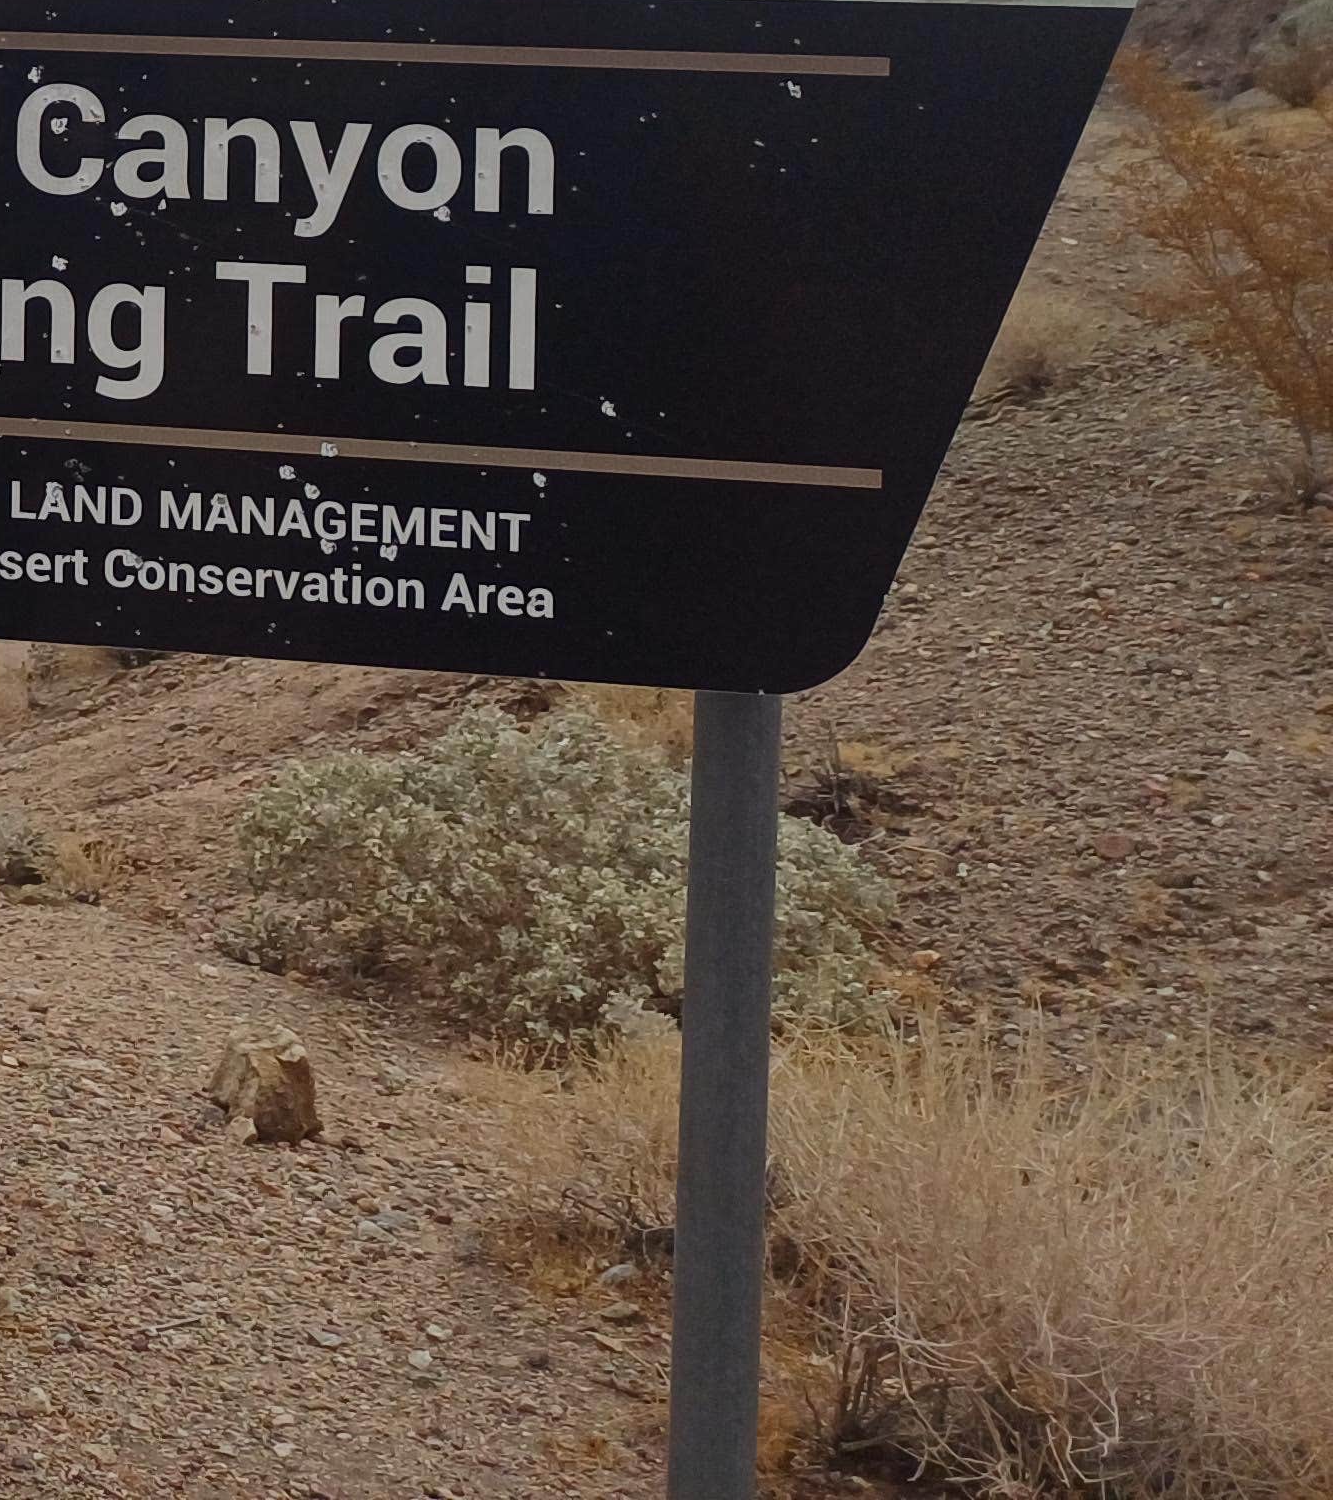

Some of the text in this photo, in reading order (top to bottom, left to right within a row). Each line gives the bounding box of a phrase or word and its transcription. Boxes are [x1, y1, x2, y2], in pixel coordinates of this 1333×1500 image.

[16, 82, 555, 238] Canyon
[215, 260, 537, 391] Trail
[11, 480, 143, 526] LAND
[159, 490, 531, 553] MANAGEMENT
[104, 550, 425, 610] Conservation
[441, 573, 554, 619] Area
